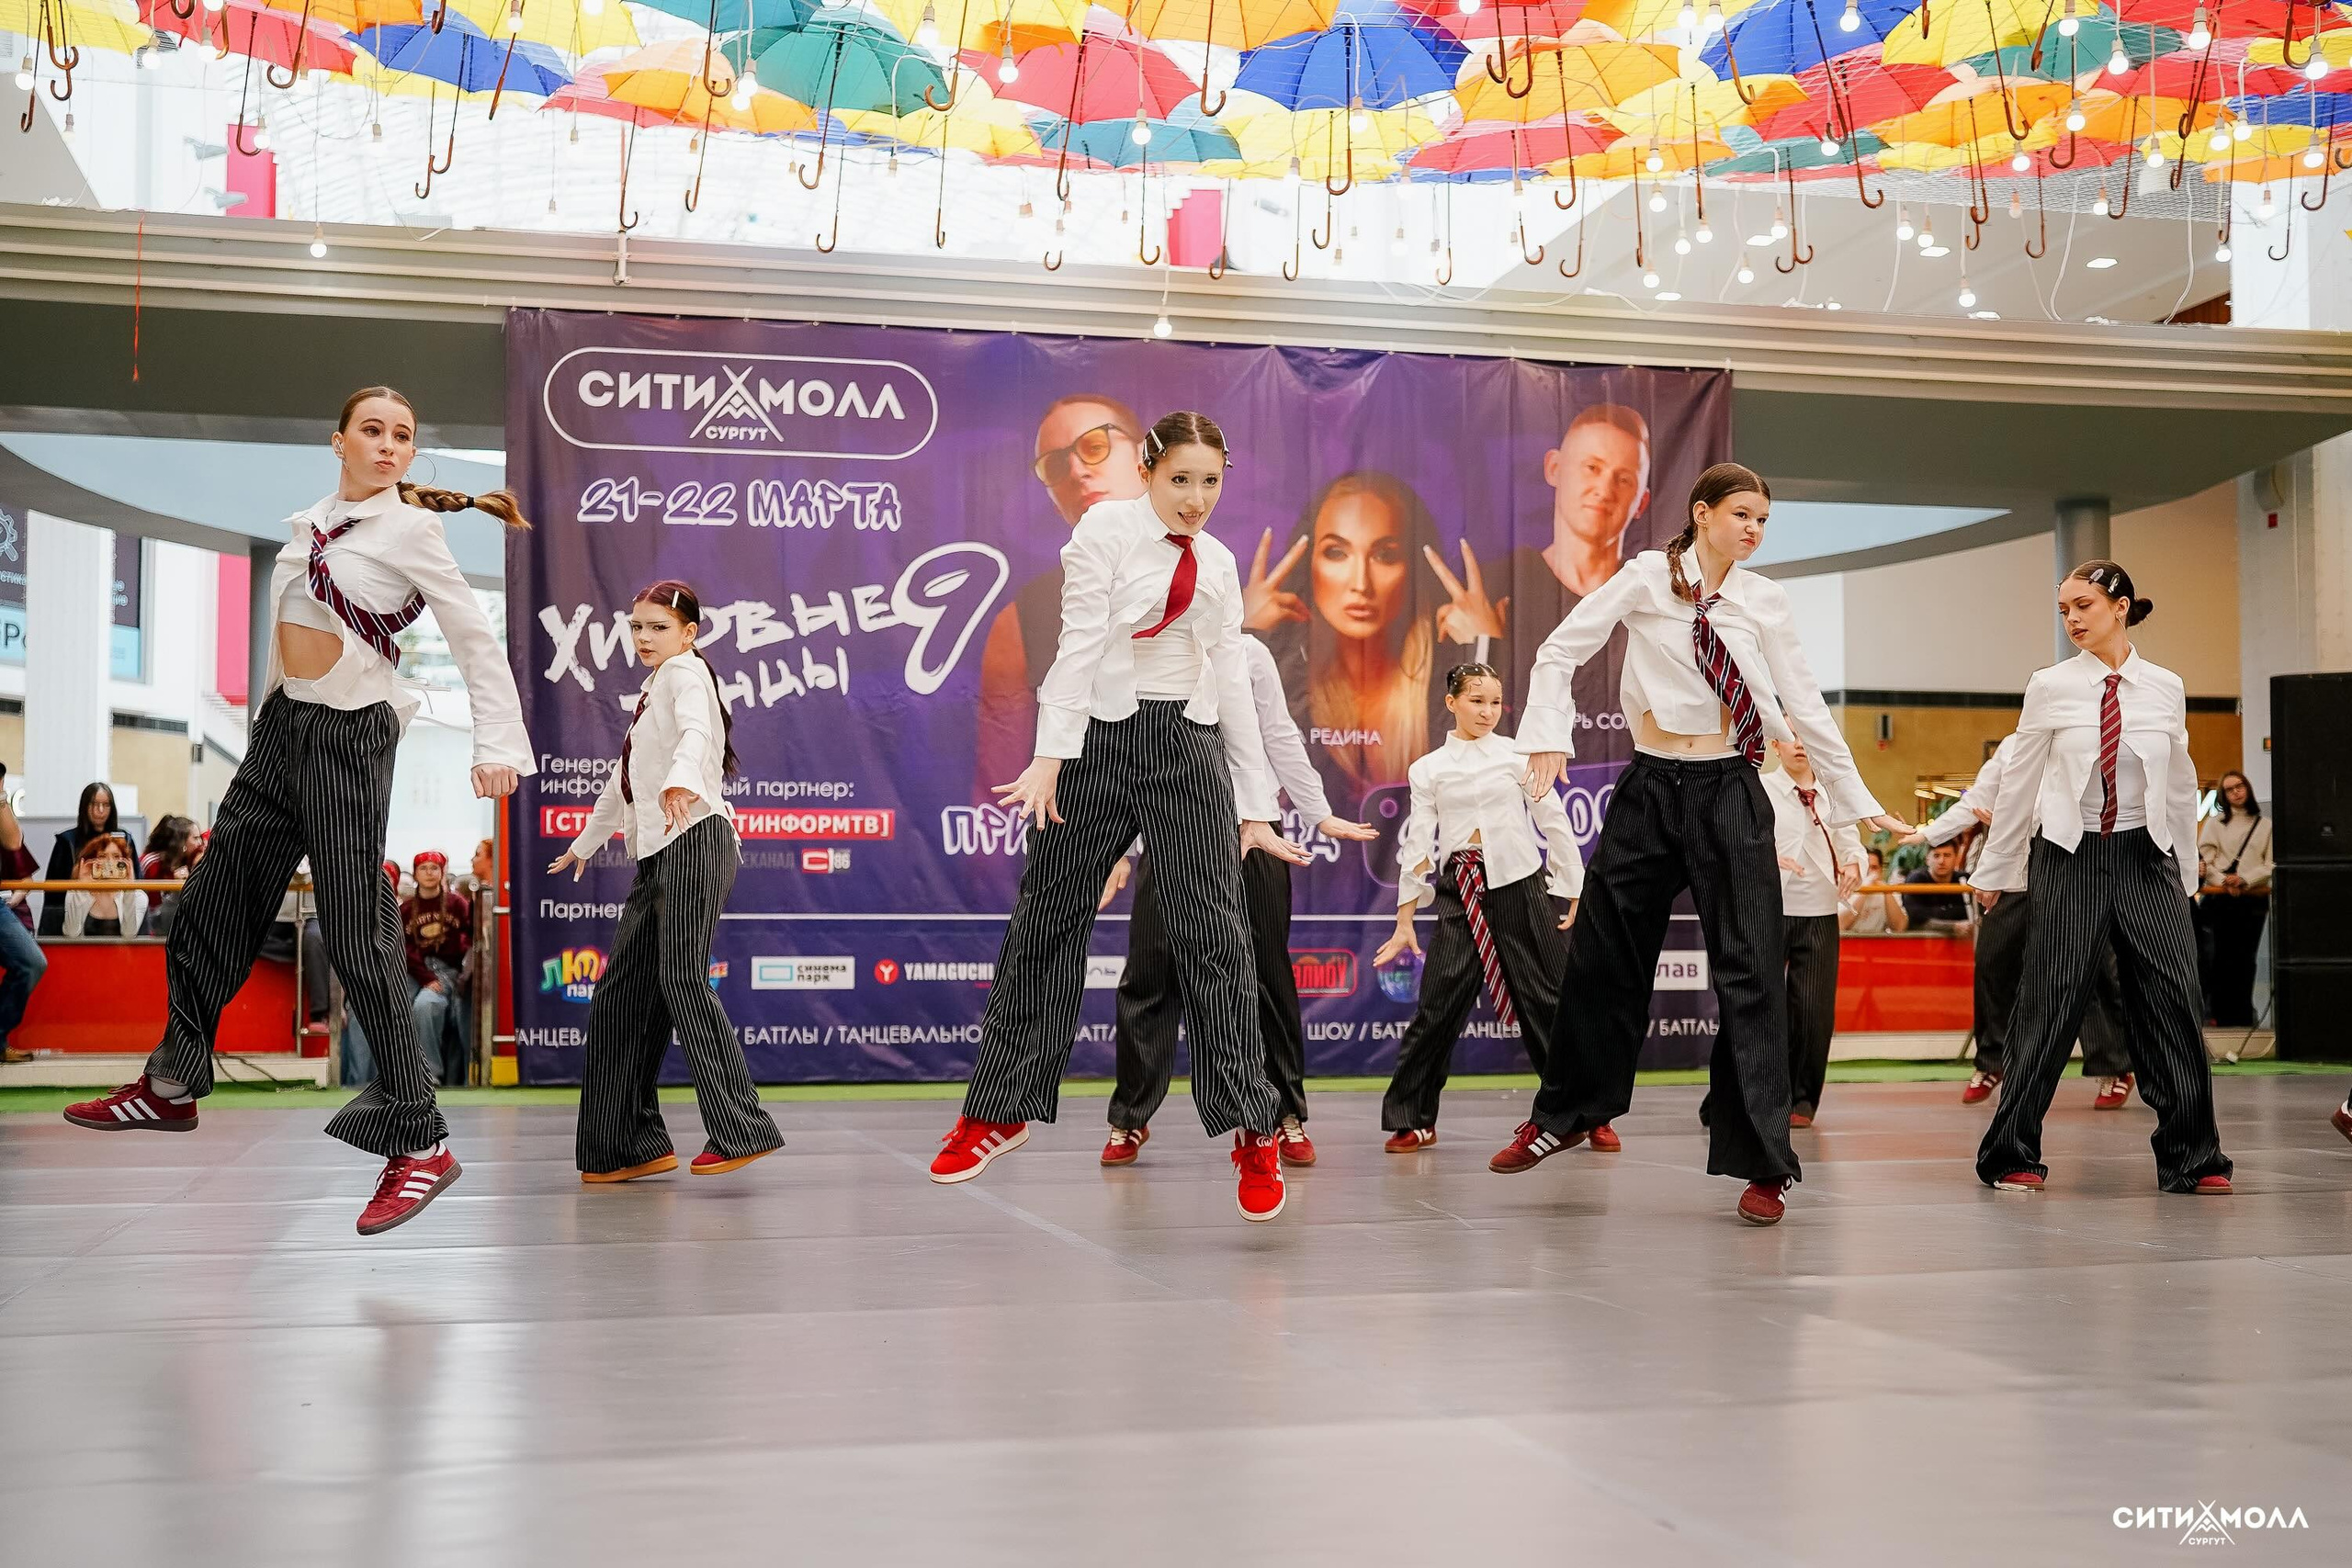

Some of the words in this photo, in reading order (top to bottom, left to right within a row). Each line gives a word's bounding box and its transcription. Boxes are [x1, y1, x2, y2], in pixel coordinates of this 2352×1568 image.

[705, 425, 769, 442] СУРГУТ
[577, 476, 737, 527] 21-22
[747, 479, 903, 532] МАРТА
[1310, 727, 1383, 747] РЕДИНА
[756, 781, 854, 801] партнер:
[736, 812, 888, 837] ТИНФОРМТВ]
[797, 974, 830, 985] парк
[904, 963, 995, 981] YAMAGUCHI
[1657, 964, 1699, 978] лав
[744, 1025, 819, 1045] БАТТЛЫ
[838, 1024, 983, 1045] ТАНЦЕВАЛЬНО
[1306, 1021, 1355, 1041] ШОУ
